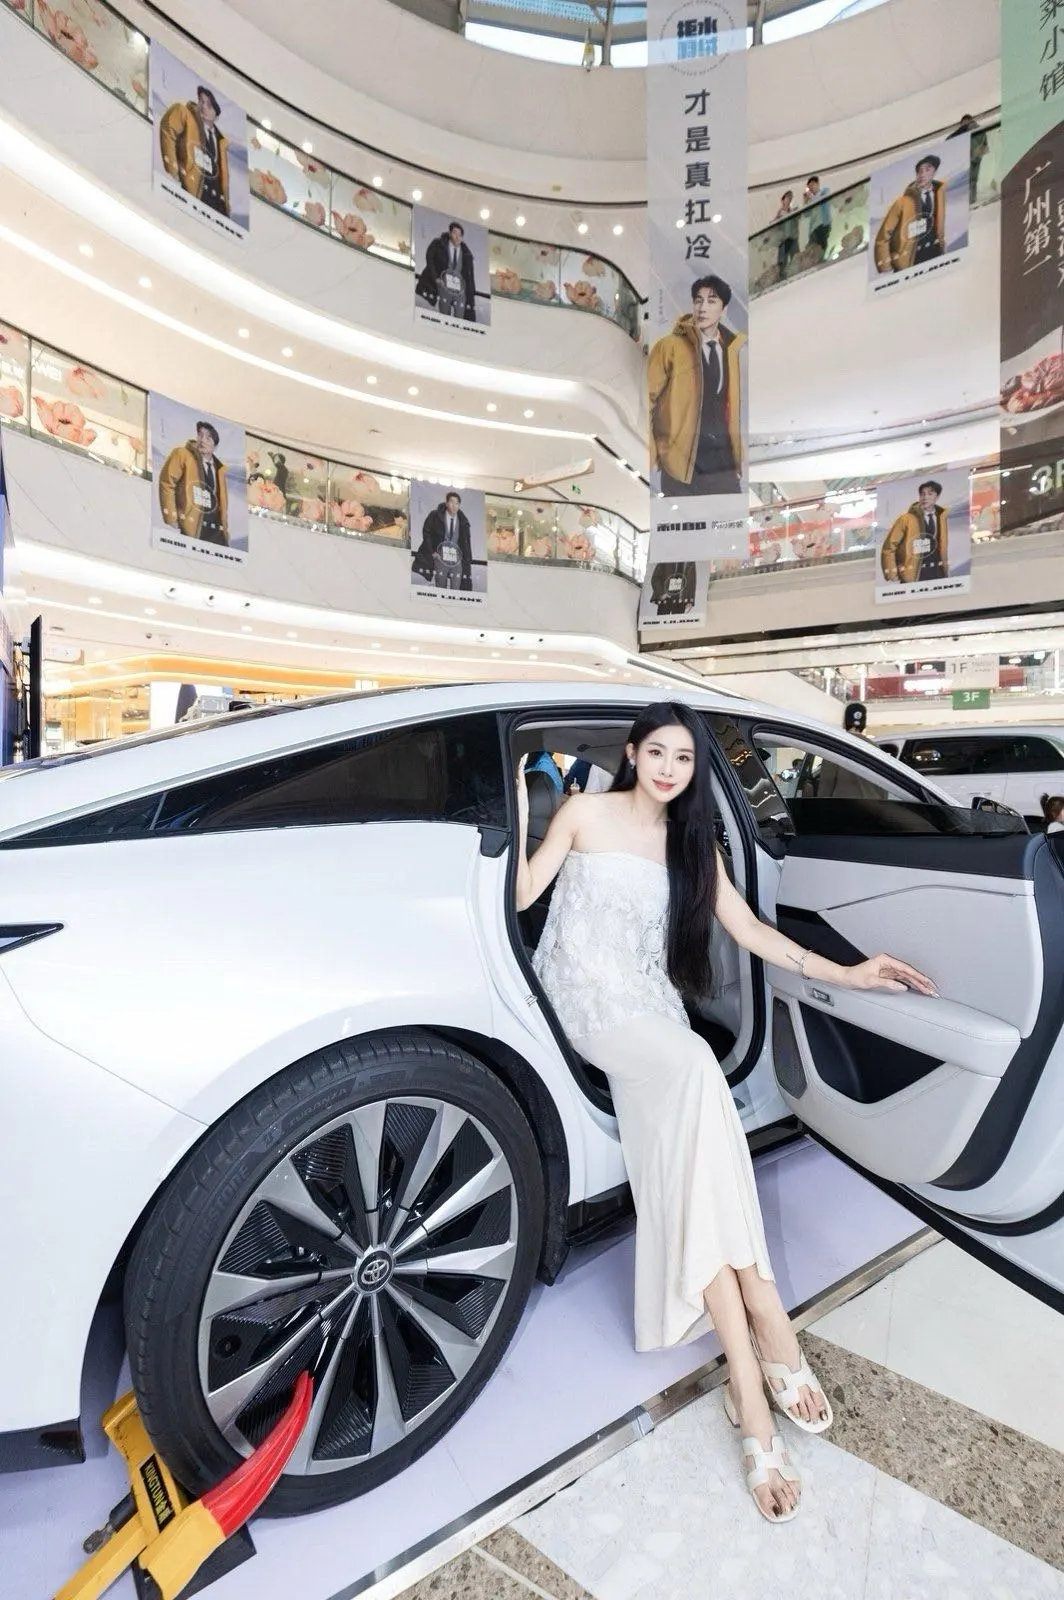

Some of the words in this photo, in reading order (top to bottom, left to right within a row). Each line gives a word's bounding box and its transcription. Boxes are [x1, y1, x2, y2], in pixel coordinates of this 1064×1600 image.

[684, 88, 712, 260] 才是真扛冷
[1023, 160, 1053, 276] 广州第一
[962, 691, 981, 702] 3F
